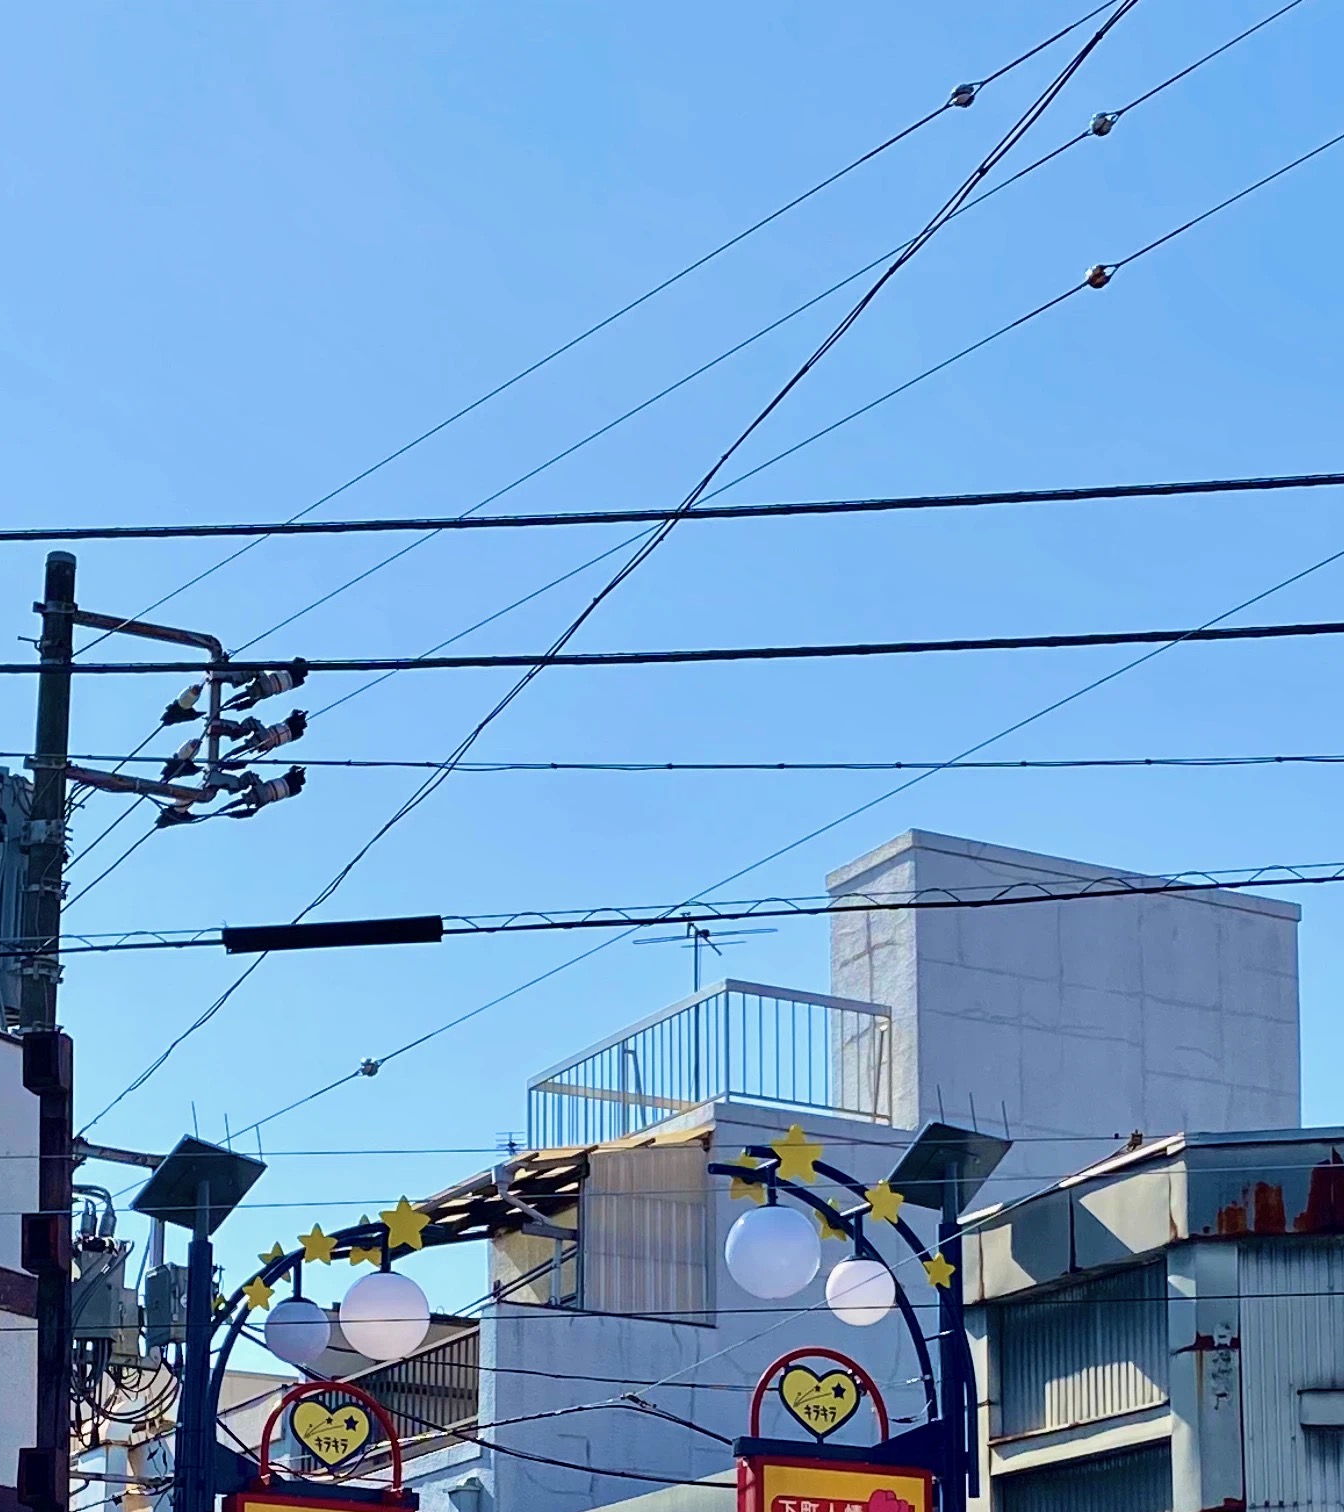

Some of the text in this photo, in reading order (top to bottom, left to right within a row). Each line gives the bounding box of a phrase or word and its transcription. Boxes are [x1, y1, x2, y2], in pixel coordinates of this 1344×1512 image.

[804, 1404, 837, 1423] キラキラ
[314, 1436, 349, 1455] キラキラ
